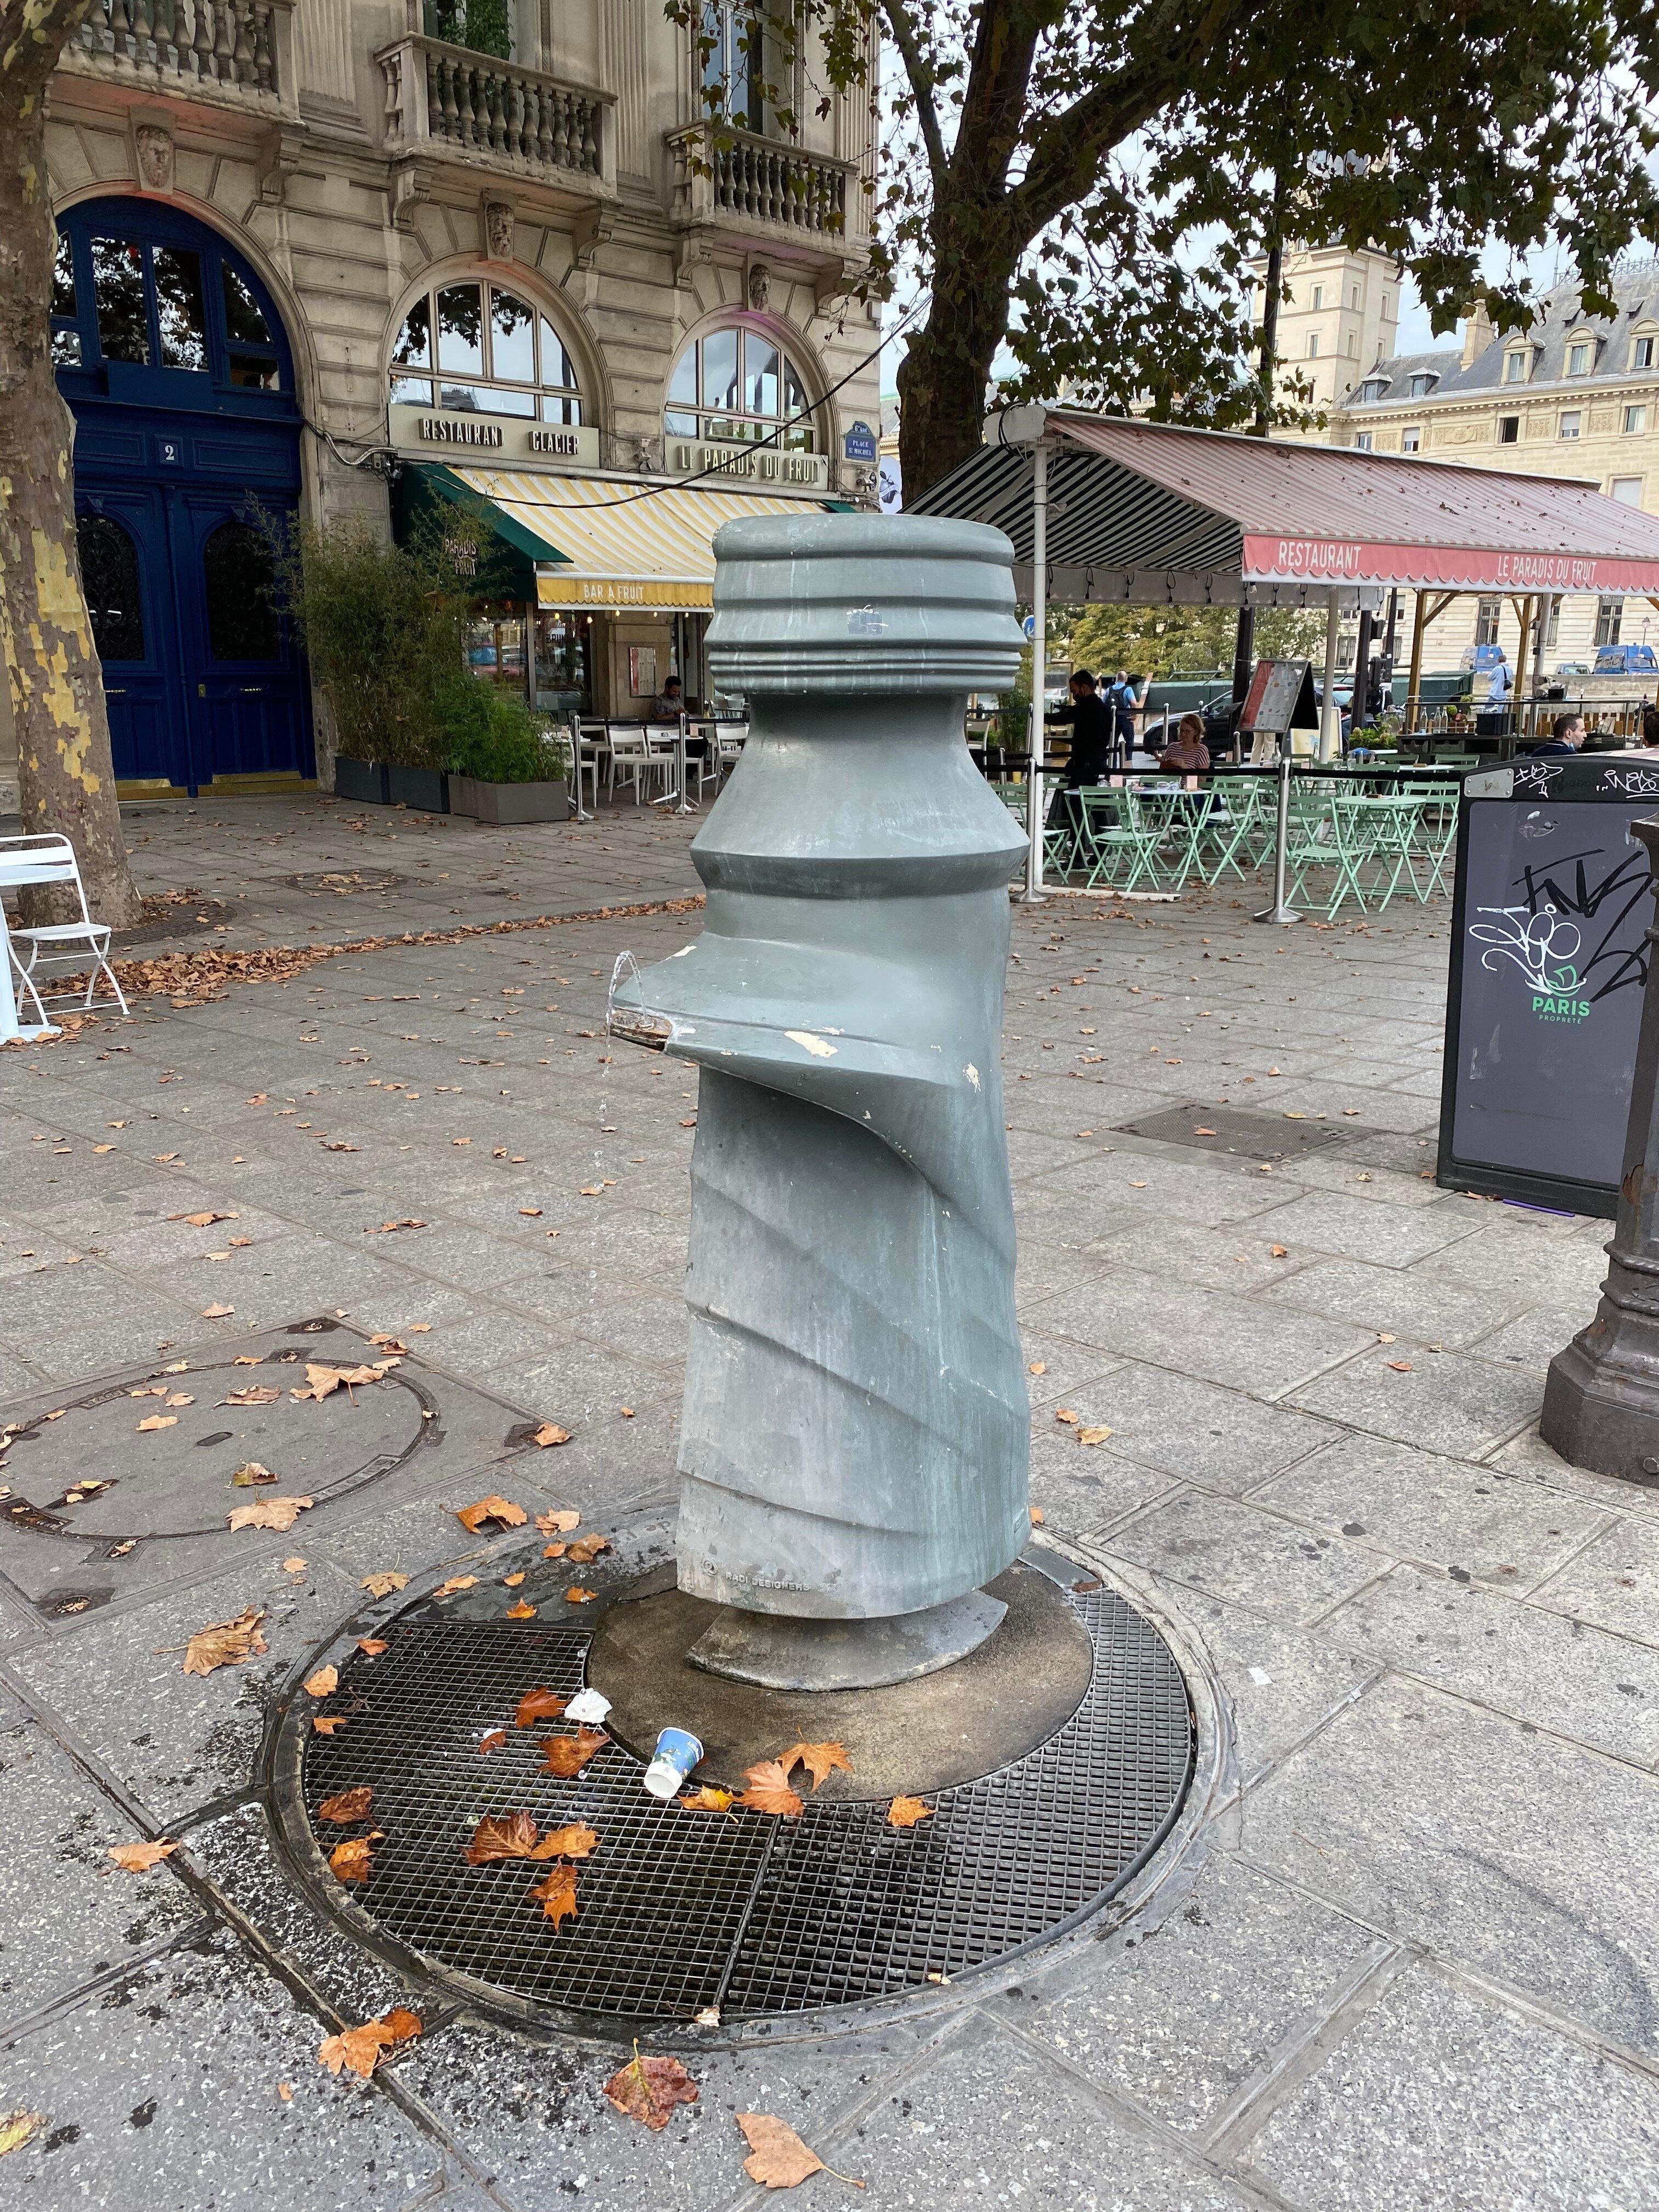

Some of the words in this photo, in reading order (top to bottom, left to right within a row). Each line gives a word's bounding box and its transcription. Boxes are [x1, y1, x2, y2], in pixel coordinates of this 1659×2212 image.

[421, 417, 505, 447] RESTAURANT
[531, 431, 580, 455] GLACIER
[165, 445, 174, 460] 2
[680, 445, 695, 469] LE
[703, 448, 758, 475] PARADIS
[765, 455, 781, 478] DU
[788, 458, 821, 482] FRUIT
[1279, 541, 1362, 569] RESTAURANT
[1498, 555, 1509, 577] LE
[1513, 556, 1554, 578] PARADIS
[1556, 559, 1570, 580] DU
[1572, 560, 1597, 581] FRUIT
[584, 584, 603, 599] BAR
[608, 585, 614, 598] A
[618, 586, 644, 600] FRUIT
[1532, 996, 1590, 1017] PARIS
[1539, 1014, 1581, 1024] PROPRETÉ
[725, 1571, 749, 1584] RADI
[752, 1577, 810, 1592] DESIGNERS
